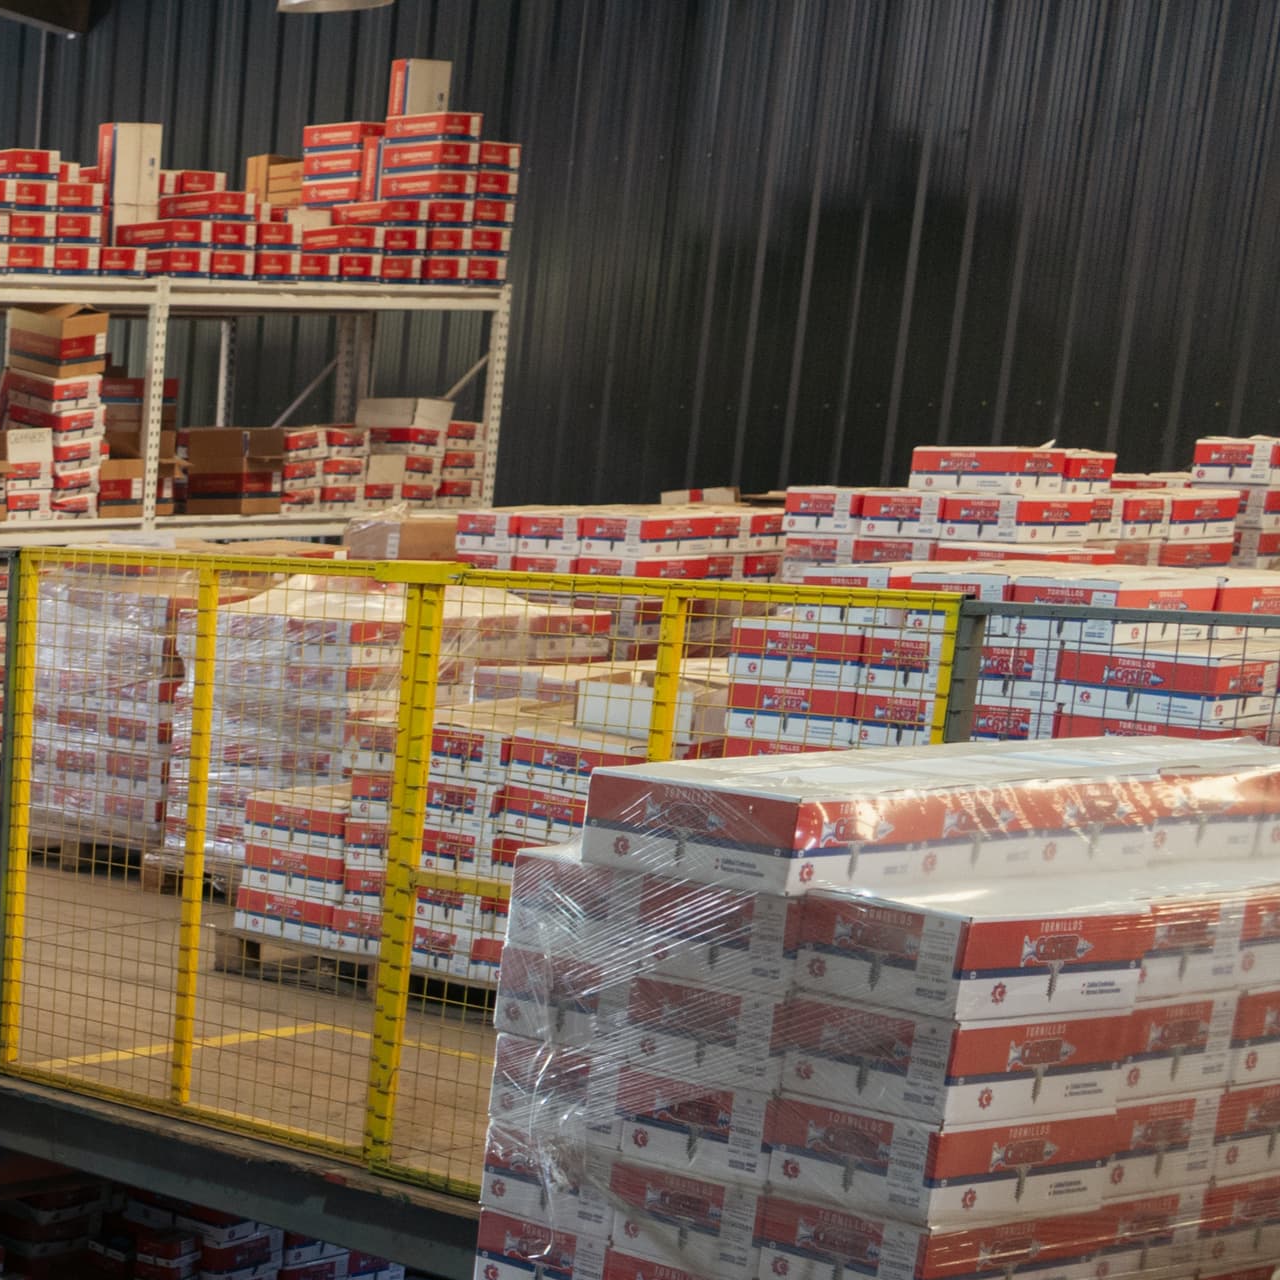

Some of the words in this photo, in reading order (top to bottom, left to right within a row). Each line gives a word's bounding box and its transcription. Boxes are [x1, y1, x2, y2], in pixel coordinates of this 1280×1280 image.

[830, 577, 861, 586] TORNILLOS
[1047, 587, 1084, 597] TORNILLOS
[894, 640, 928, 649] TORNILLOS
[989, 656, 1024, 673] CASER
[1117, 657, 1156, 669] TORNILLOS
[1113, 667, 1151, 686] CASER
[774, 687, 805, 696] TORNILLOS
[986, 716, 1021, 733] CASER
[1119, 721, 1157, 732] TORNILLOS
[1040, 920, 1084, 932] TORNILLOS
[1026, 1024, 1067, 1038] TORNILLOS
[828, 1111, 884, 1134] TORNILLOS
[1008, 1125, 1051, 1138] TORNILLOS
[818, 1209, 876, 1234] TORNILLOS
